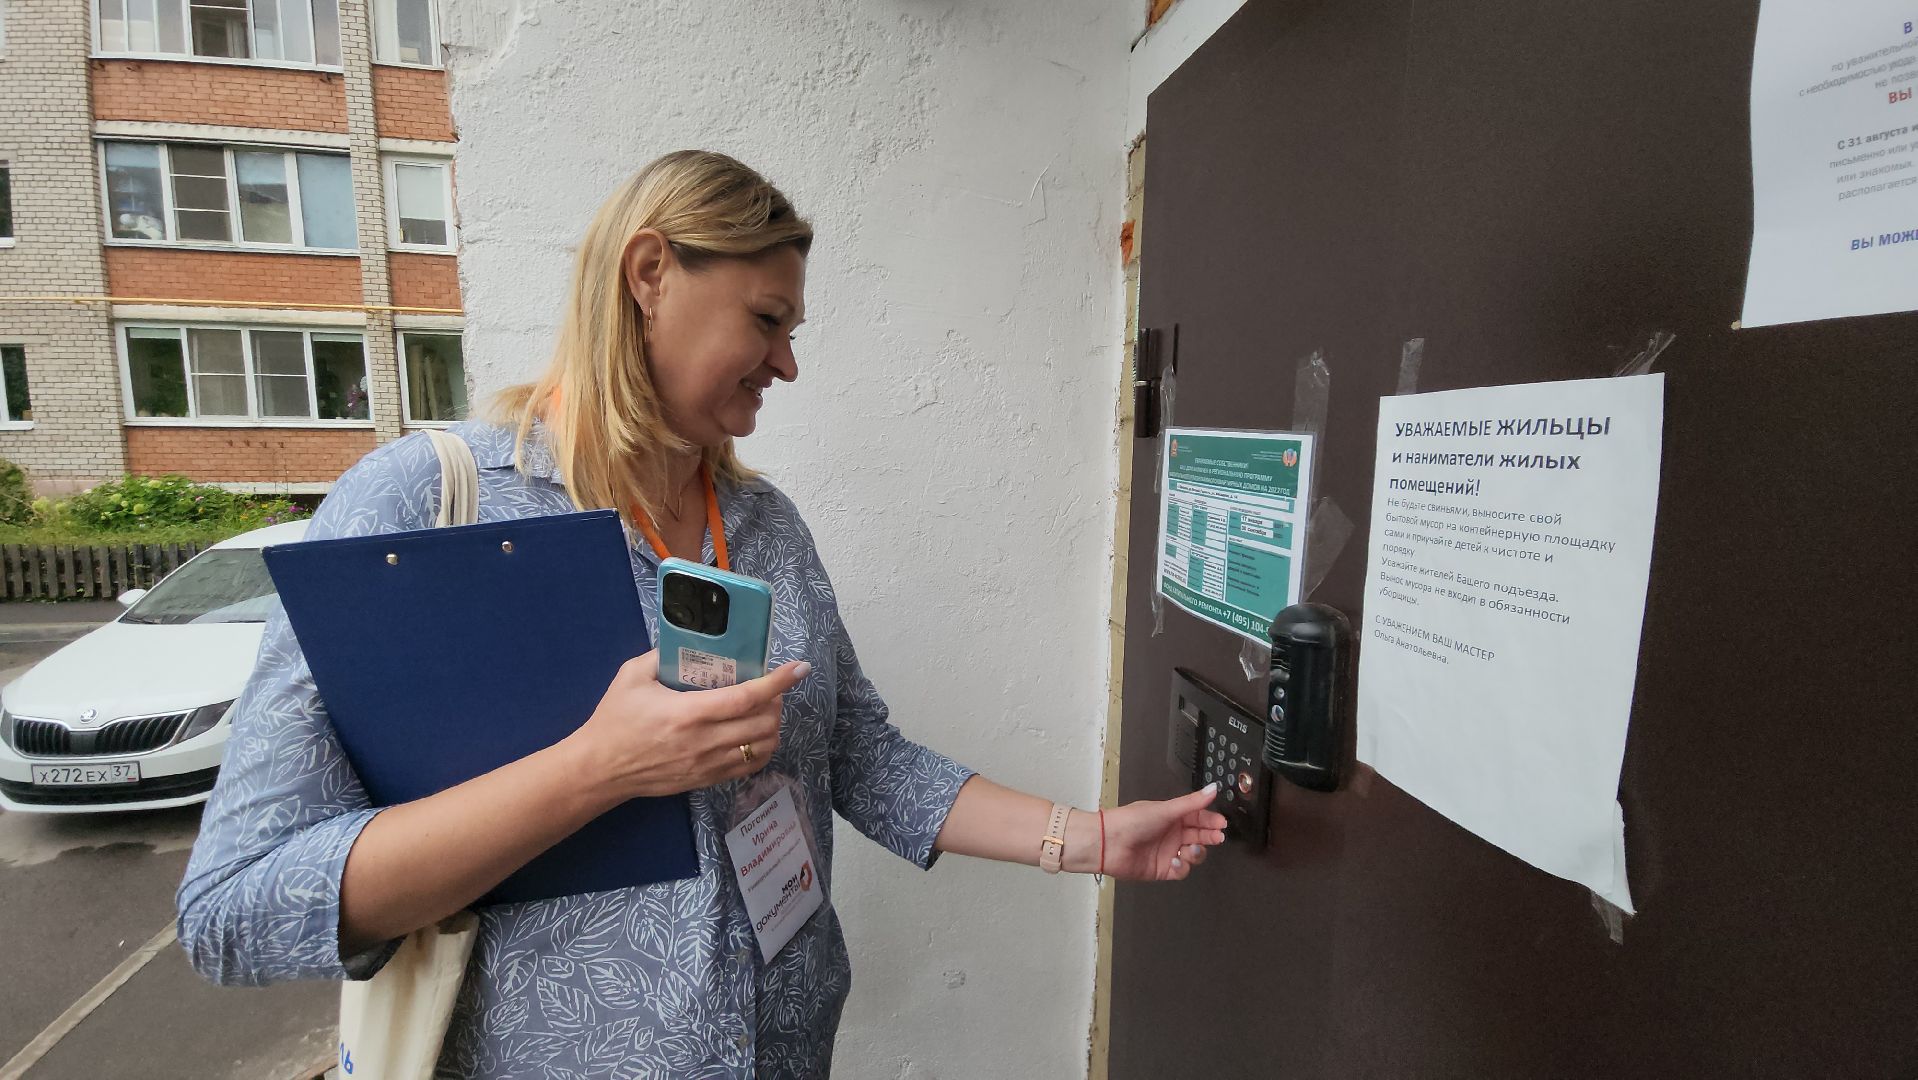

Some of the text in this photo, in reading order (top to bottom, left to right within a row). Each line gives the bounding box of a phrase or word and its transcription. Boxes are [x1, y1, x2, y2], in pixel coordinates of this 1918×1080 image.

[1888, 87, 1912, 104] ВЫ
[1847, 136, 1863, 148] 31
[1865, 126, 1908, 143] августа
[1829, 149, 1885, 169] письменно
[1888, 143, 1907, 155] или
[1836, 173, 1857, 184] или
[1838, 176, 1917, 201] располагается
[1850, 236, 1873, 250] ВЫ
[1395, 416, 1611, 440] УВАЖАЕМЫЕ ЖИЛЬЦЫ
[1392, 451, 1582, 470] и наниматели жилых
[1389, 478, 1481, 496] помещений!
[1387, 498, 1562, 525] Не будьте свиньями, выносите свой
[1386, 512, 1616, 553] бытовой мусор на контейнерную площадку
[1383, 543, 1415, 558] порядку
[1384, 528, 1405, 539] сами
[1406, 531, 1411, 539] и
[1412, 533, 1453, 548] приучайте
[1455, 540, 1482, 552] детей
[1491, 546, 1541, 561] чистоте
[1544, 553, 1553, 563] и
[1381, 556, 1418, 572] Уважайте
[1418, 566, 1454, 581] жителей
[1493, 583, 1559, 603] подъезда.
[1380, 571, 1570, 625] Вынос мусора не входит в обязанности
[1222, 609, 1231, 619] +7
[1232, 611, 1250, 630] (495)
[1374, 629, 1449, 665] Ольга Анатольевна.
[1375, 614, 1495, 661] С УВАЖЕНИЕМ ВАШ МАСТЕР
[113, 765, 131, 777] 37
[752, 820, 778, 846] Ирина
[740, 821, 796, 877] Владимировна
[781, 873, 798, 894] мои
[756, 881, 801, 933] документы
